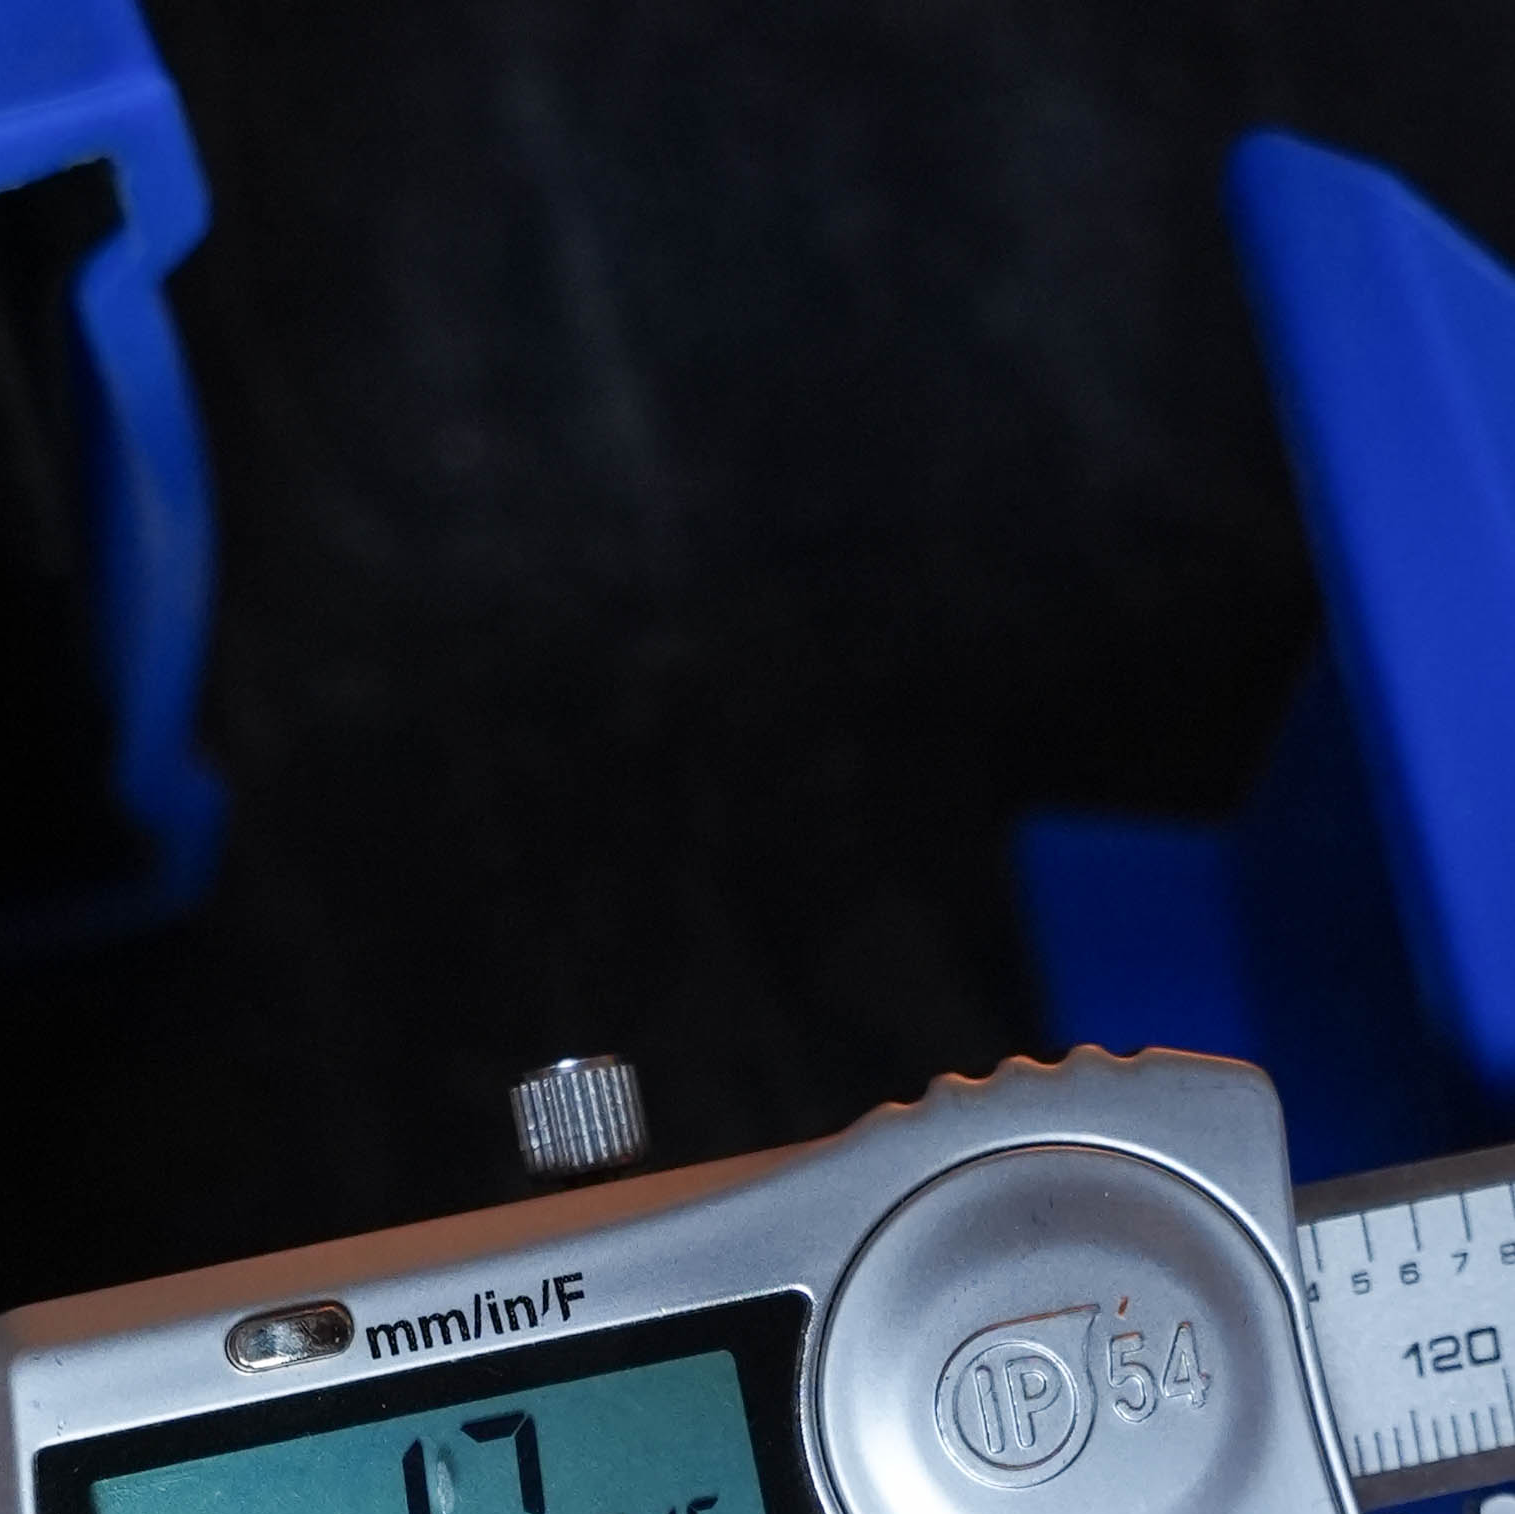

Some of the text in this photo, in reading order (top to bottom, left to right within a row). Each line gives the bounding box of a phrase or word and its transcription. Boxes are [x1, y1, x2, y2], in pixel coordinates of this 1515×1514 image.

[1351, 1271, 1371, 1295] 5
[1399, 1261, 1421, 1286] 6
[1451, 1251, 1469, 1273] 7
[365, 1272, 585, 1360] mm/in/F
[1402, 1325, 1502, 1378] 120
[974, 1321, 1213, 1455] IP 54
